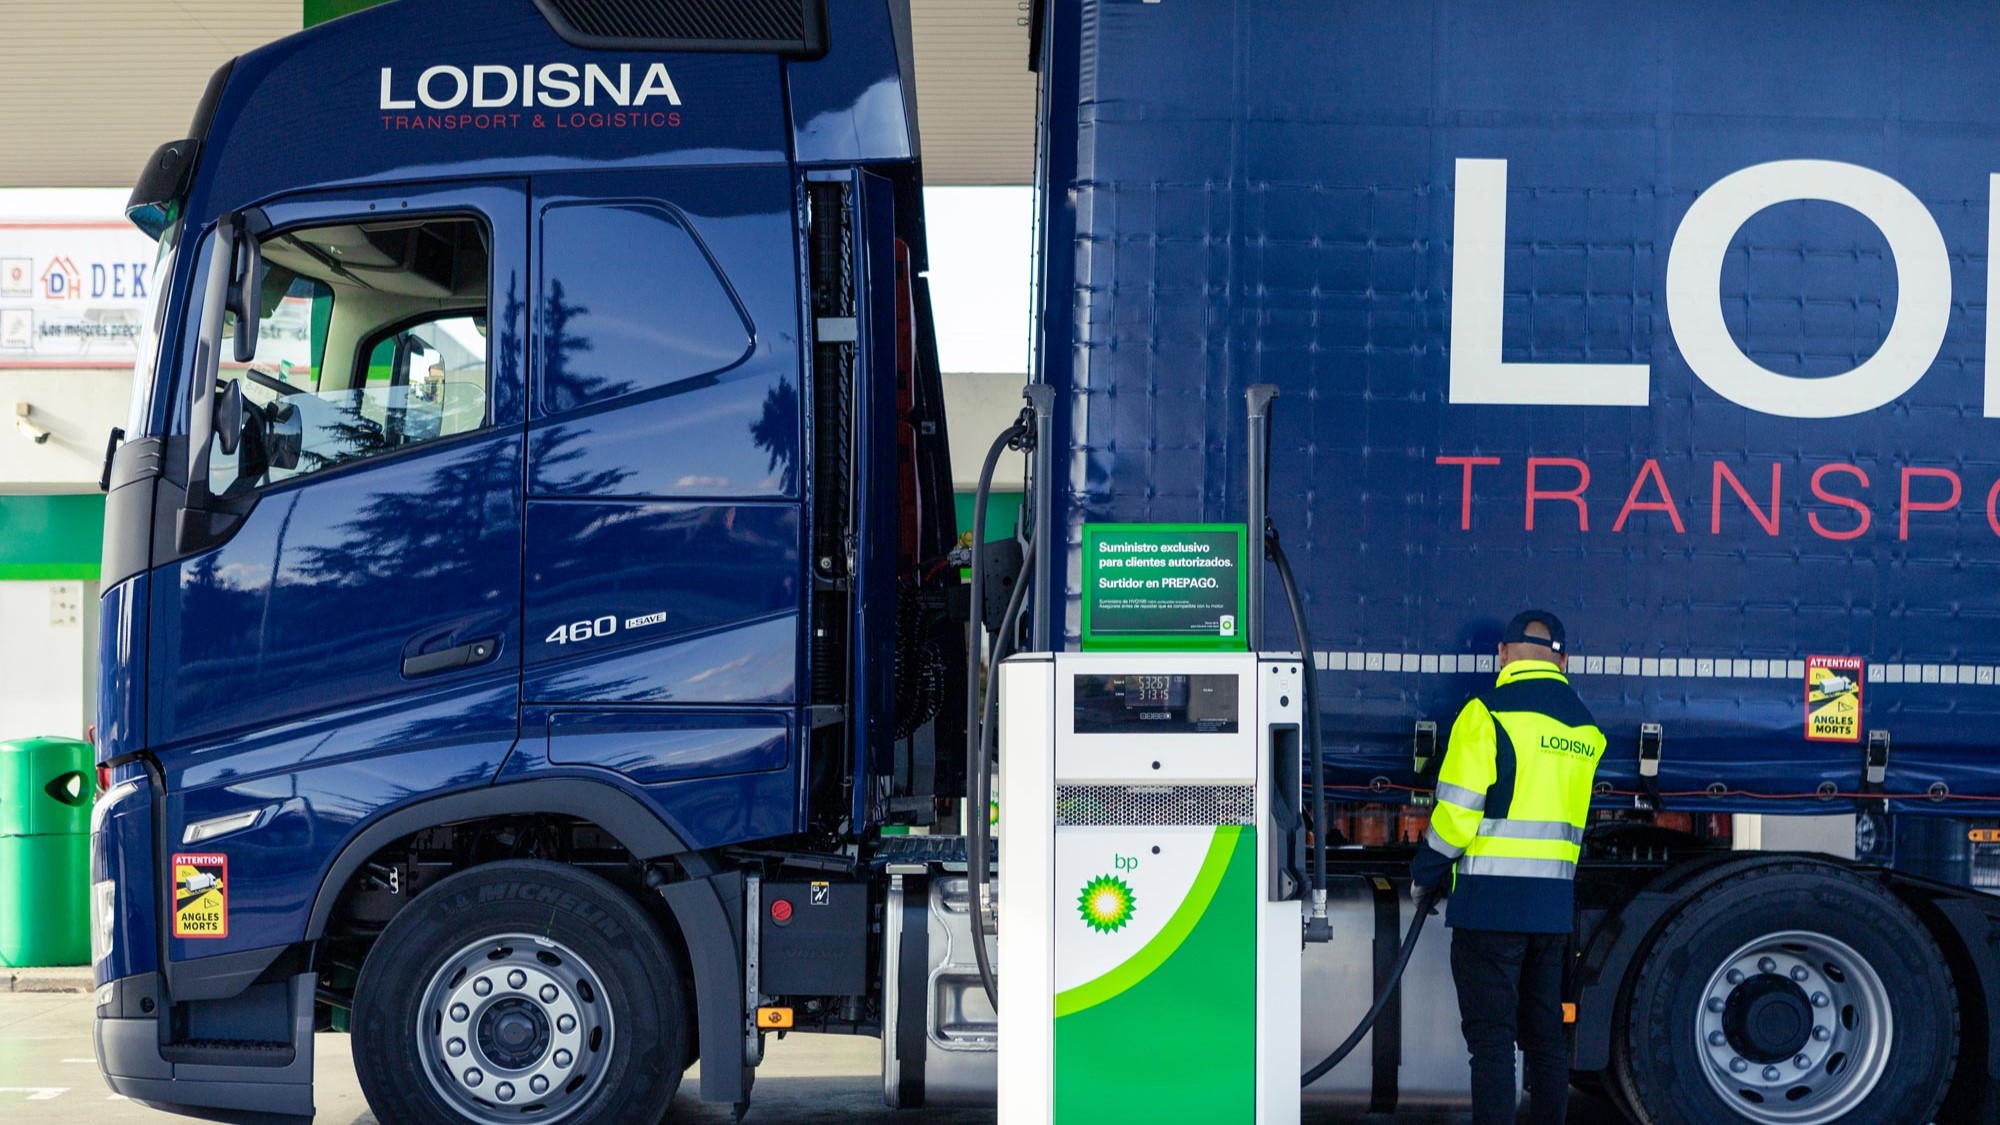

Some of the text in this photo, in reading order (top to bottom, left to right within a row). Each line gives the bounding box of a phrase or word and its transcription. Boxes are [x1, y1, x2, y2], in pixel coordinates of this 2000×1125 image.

[380, 63, 682, 110] LODISNA
[381, 112, 681, 130] TRANSPORT & LOGISTICS
[91, 263, 147, 298] DEK
[1449, 158, 2000, 419] LO
[1099, 542, 1210, 553] Suministro exclusivo
[1099, 557, 1233, 569] para clientes autorizados.
[1099, 578, 1219, 588] Surtidor en PREPAGO.
[545, 613, 665, 645] 460 I-SAVE
[1810, 658, 1860, 668] ATTENTION
[1814, 715, 1853, 725] ANGLES
[1816, 725, 1851, 735] MORTS
[176, 856, 224, 864] ATTENTION
[1115, 853, 1139, 873] bp
[479, 882, 626, 938] MICHELIN
[181, 913, 219, 921] ANGLES
[183, 922, 218, 930] MORTS
